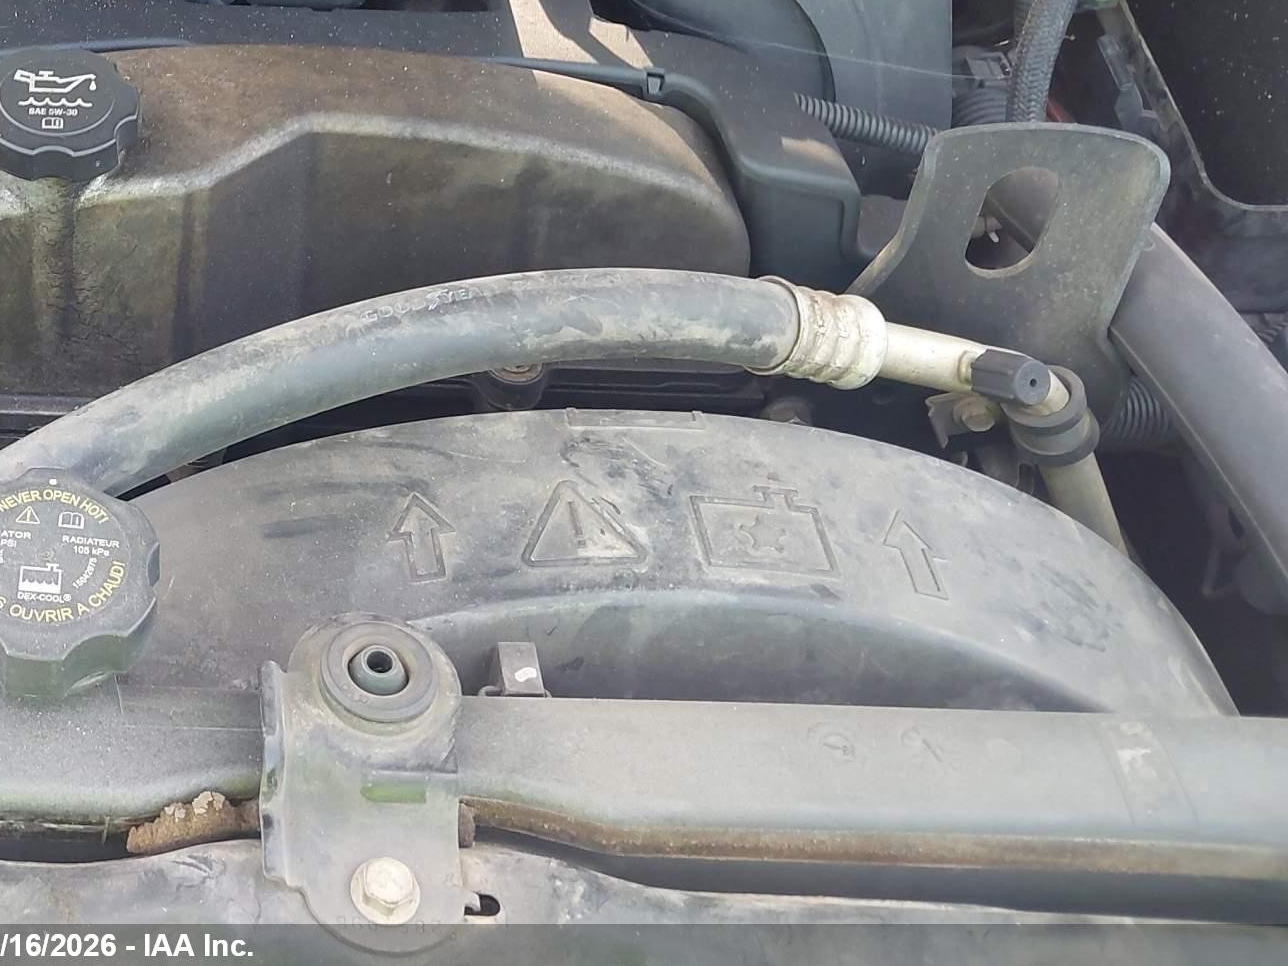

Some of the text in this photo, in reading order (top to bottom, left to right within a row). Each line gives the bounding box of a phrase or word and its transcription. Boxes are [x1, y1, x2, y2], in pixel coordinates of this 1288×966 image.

[48, 108, 78, 116] 5W-30
[43, 488, 80, 506] OPEN
[80, 500, 110, 524] HOT!
[0, 538, 17, 547] PSI
[62, 535, 120, 548] RADIATEUR
[91, 547, 110, 557] kPa
[9, 603, 74, 622] OUVRIR
[88, 561, 126, 608] CHAUD!
